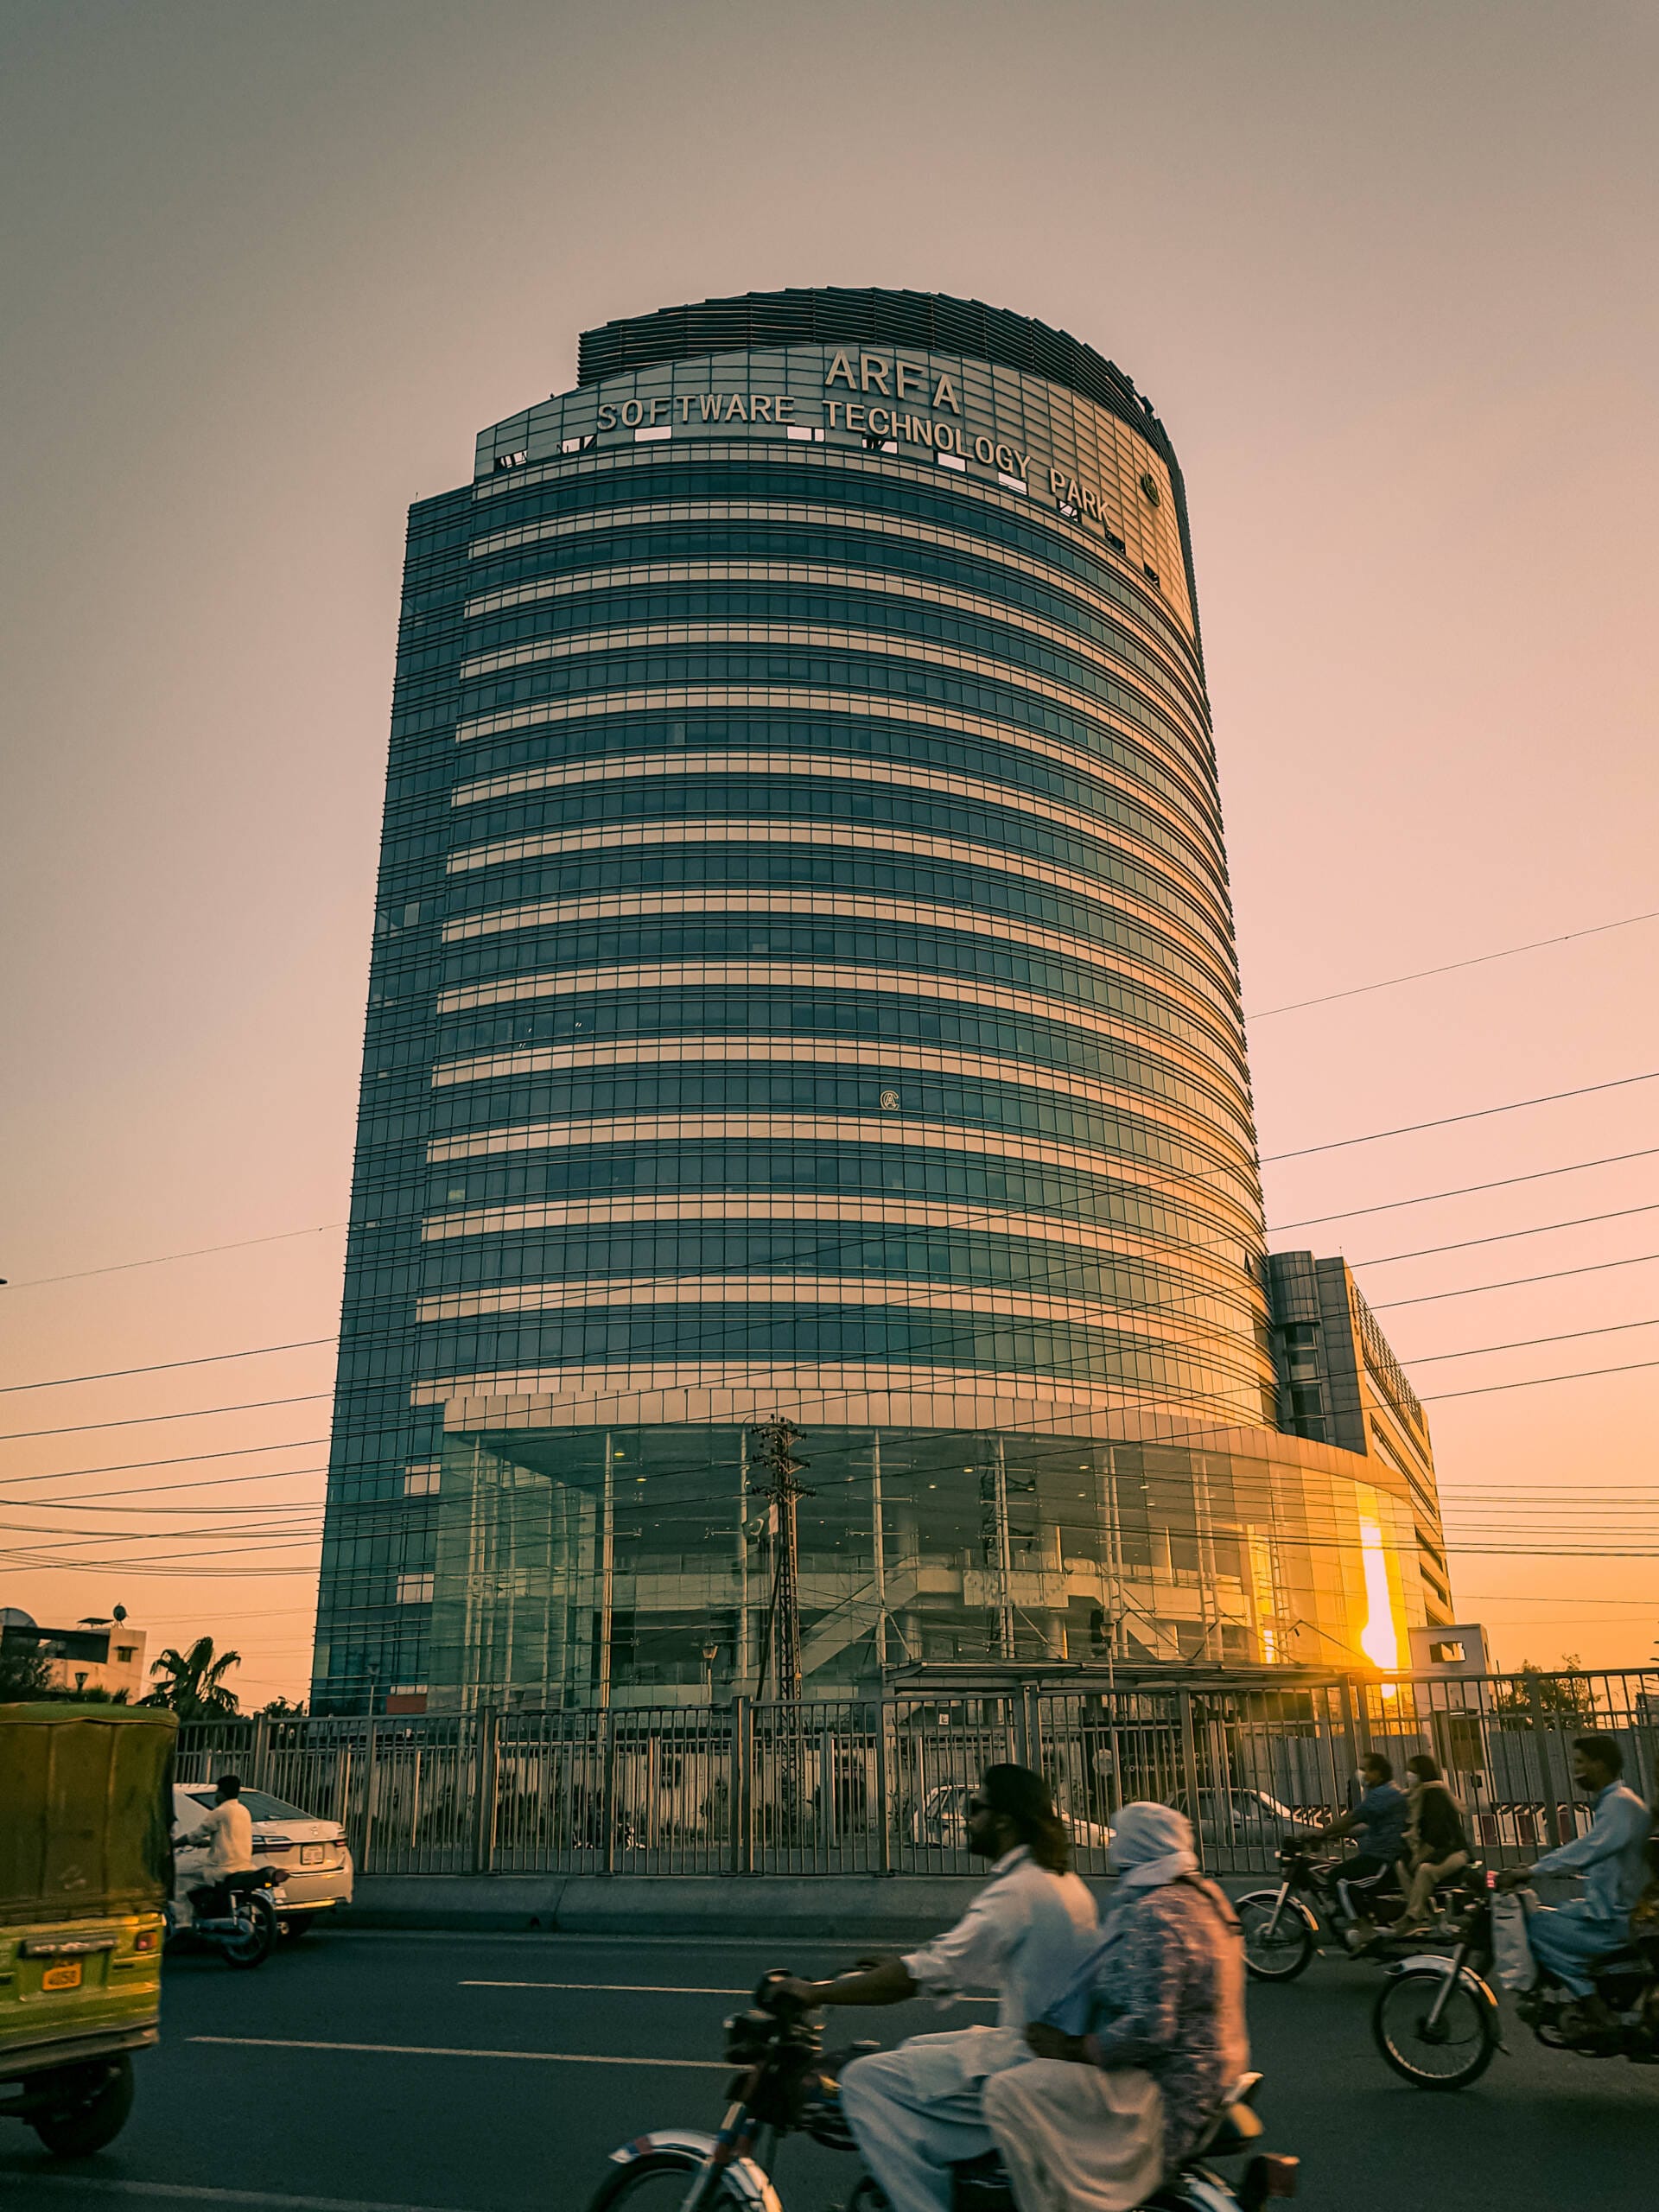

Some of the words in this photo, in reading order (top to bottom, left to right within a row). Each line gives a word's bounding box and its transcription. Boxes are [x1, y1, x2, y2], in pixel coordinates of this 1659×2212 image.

[825, 350, 961, 415] ARFA
[596, 394, 795, 430] SOFTWARE
[822, 400, 1031, 479] TECHNOLOGY
[1048, 467, 1112, 529] PARK
